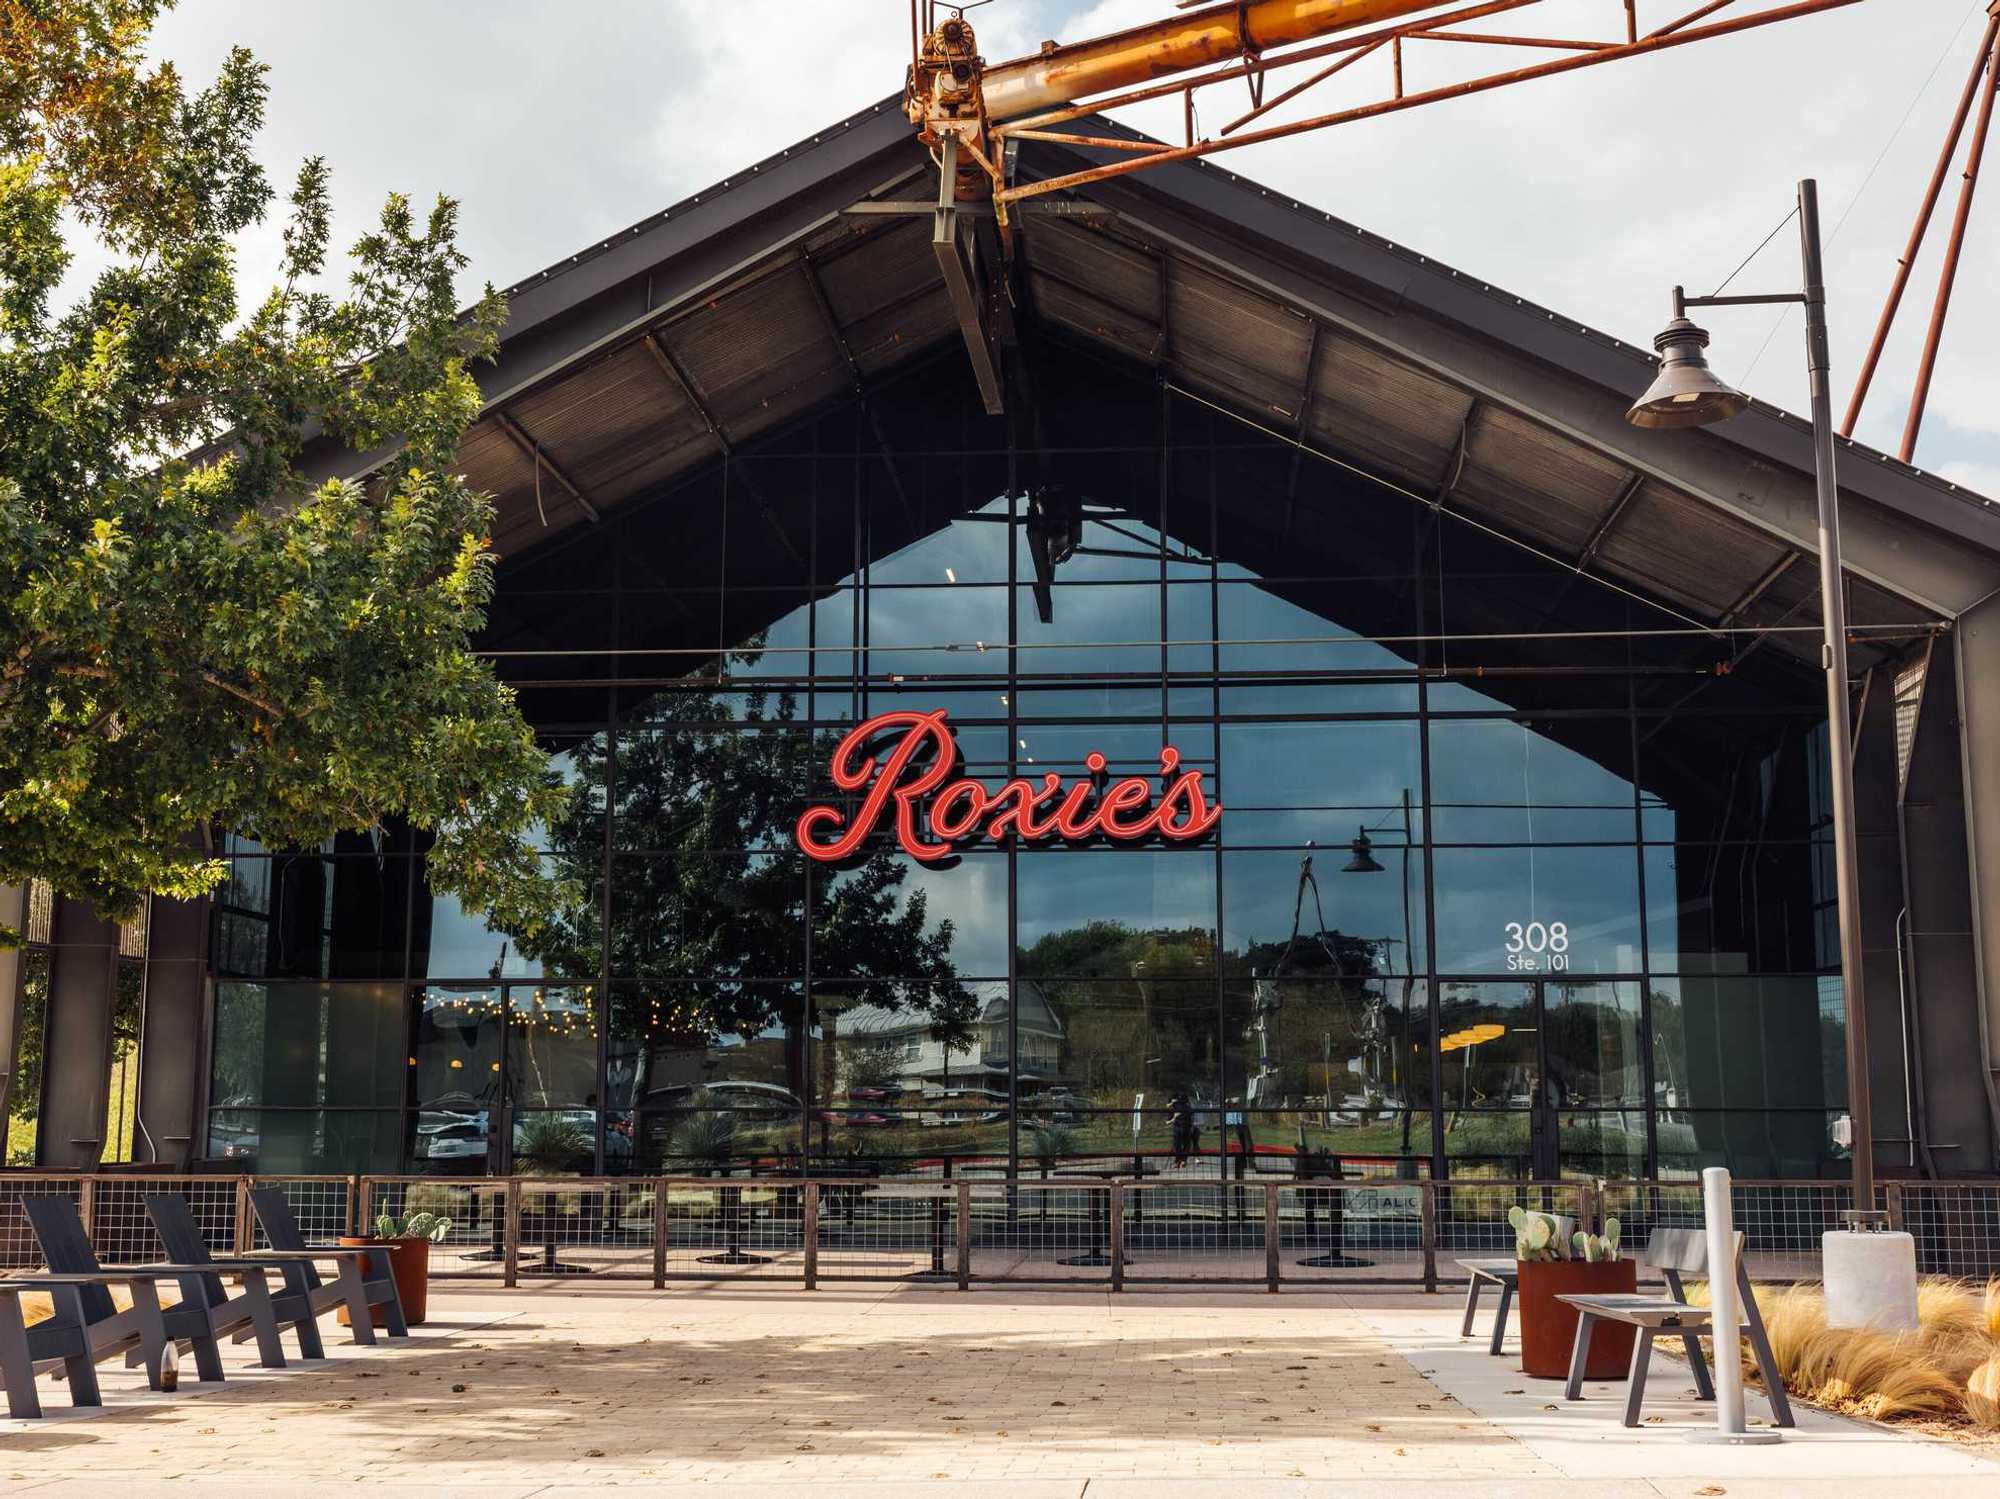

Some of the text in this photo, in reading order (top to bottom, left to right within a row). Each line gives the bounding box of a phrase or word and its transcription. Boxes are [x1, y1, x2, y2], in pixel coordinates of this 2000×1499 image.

[796, 708, 1222, 861] Roxie's
[1504, 922, 1569, 953] 308
[1506, 954, 1569, 971] Ste. 101
